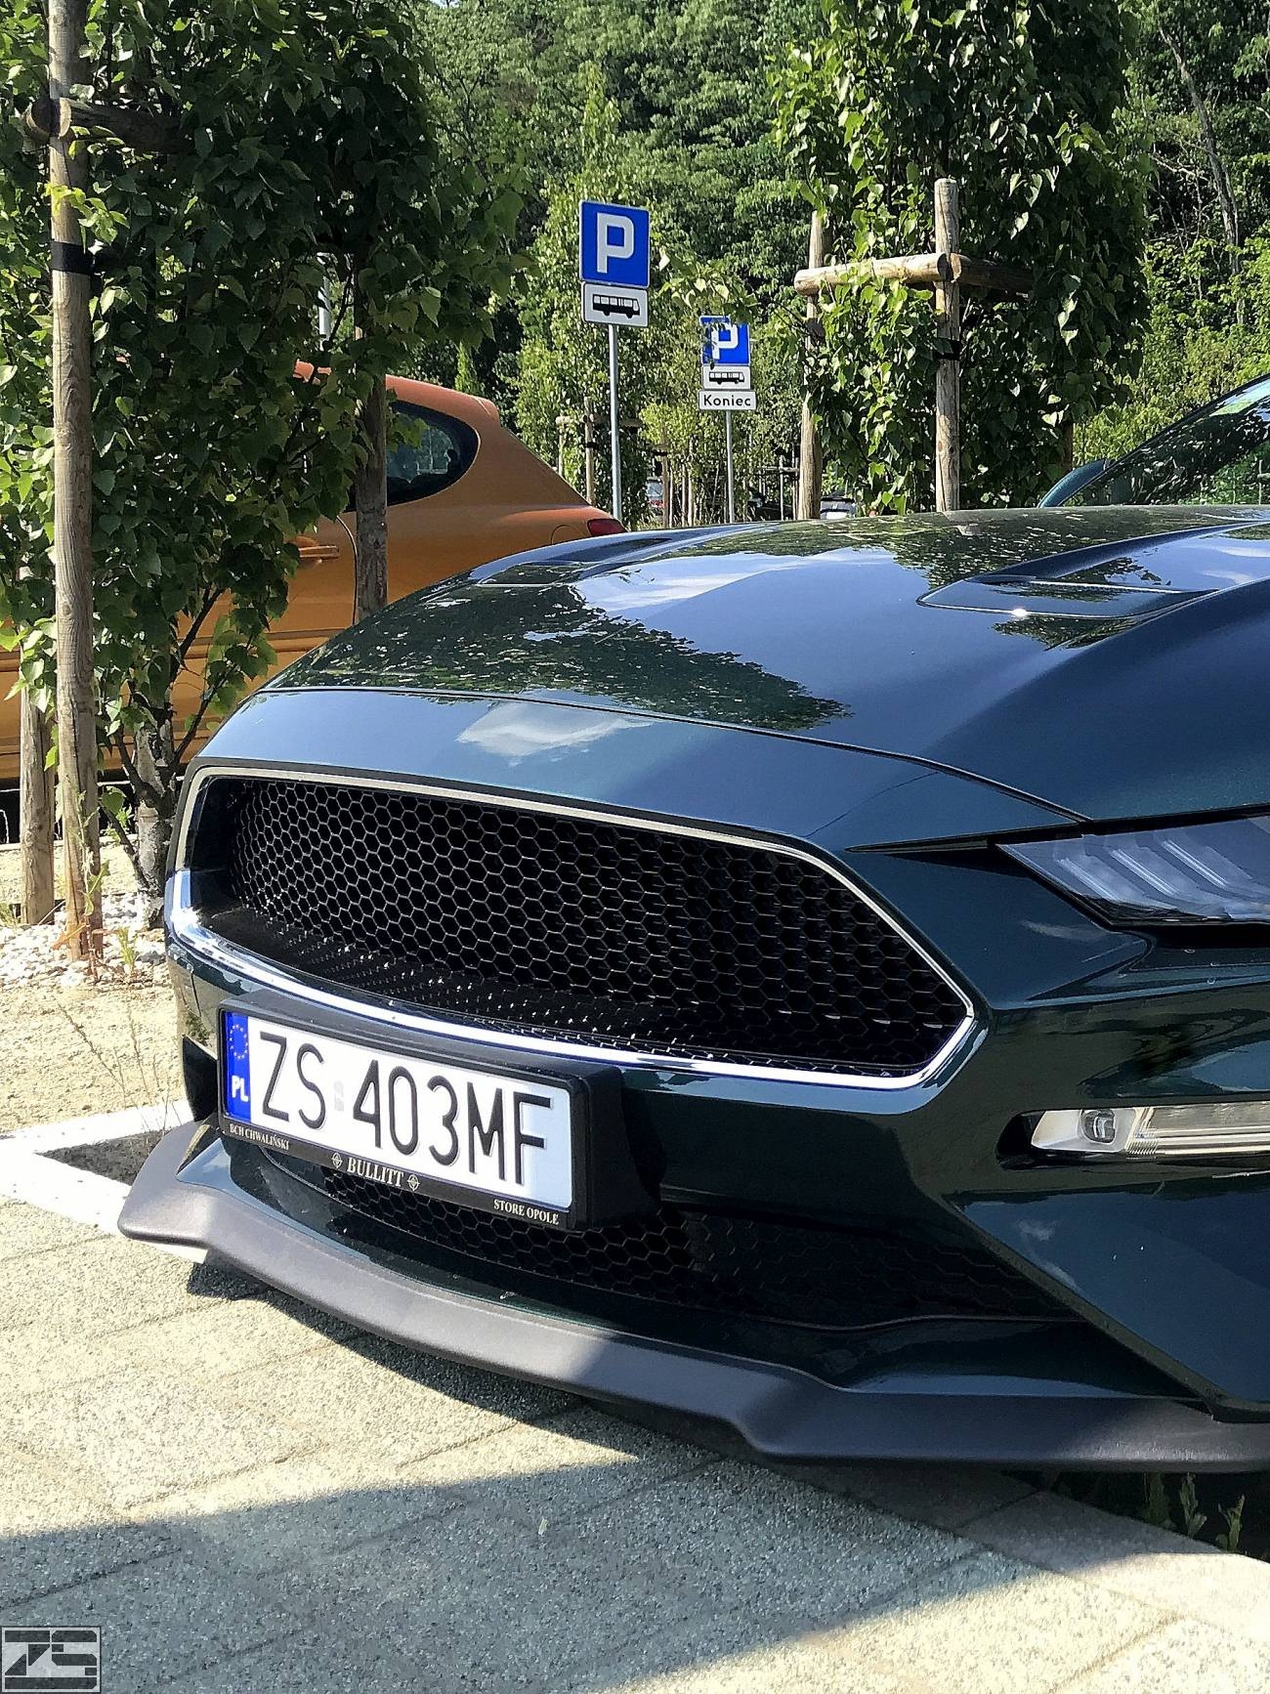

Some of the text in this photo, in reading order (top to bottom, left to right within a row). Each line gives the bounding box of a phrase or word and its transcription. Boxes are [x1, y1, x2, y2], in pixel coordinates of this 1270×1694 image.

[597, 212, 634, 274] P
[711, 322, 739, 360] P
[702, 394, 751, 408] Koniec
[232, 1074, 250, 1103] PL
[259, 1030, 553, 1187] ZS 403MF
[346, 1156, 405, 1188] BULLITT
[493, 1198, 560, 1226] STORE OPOLE
